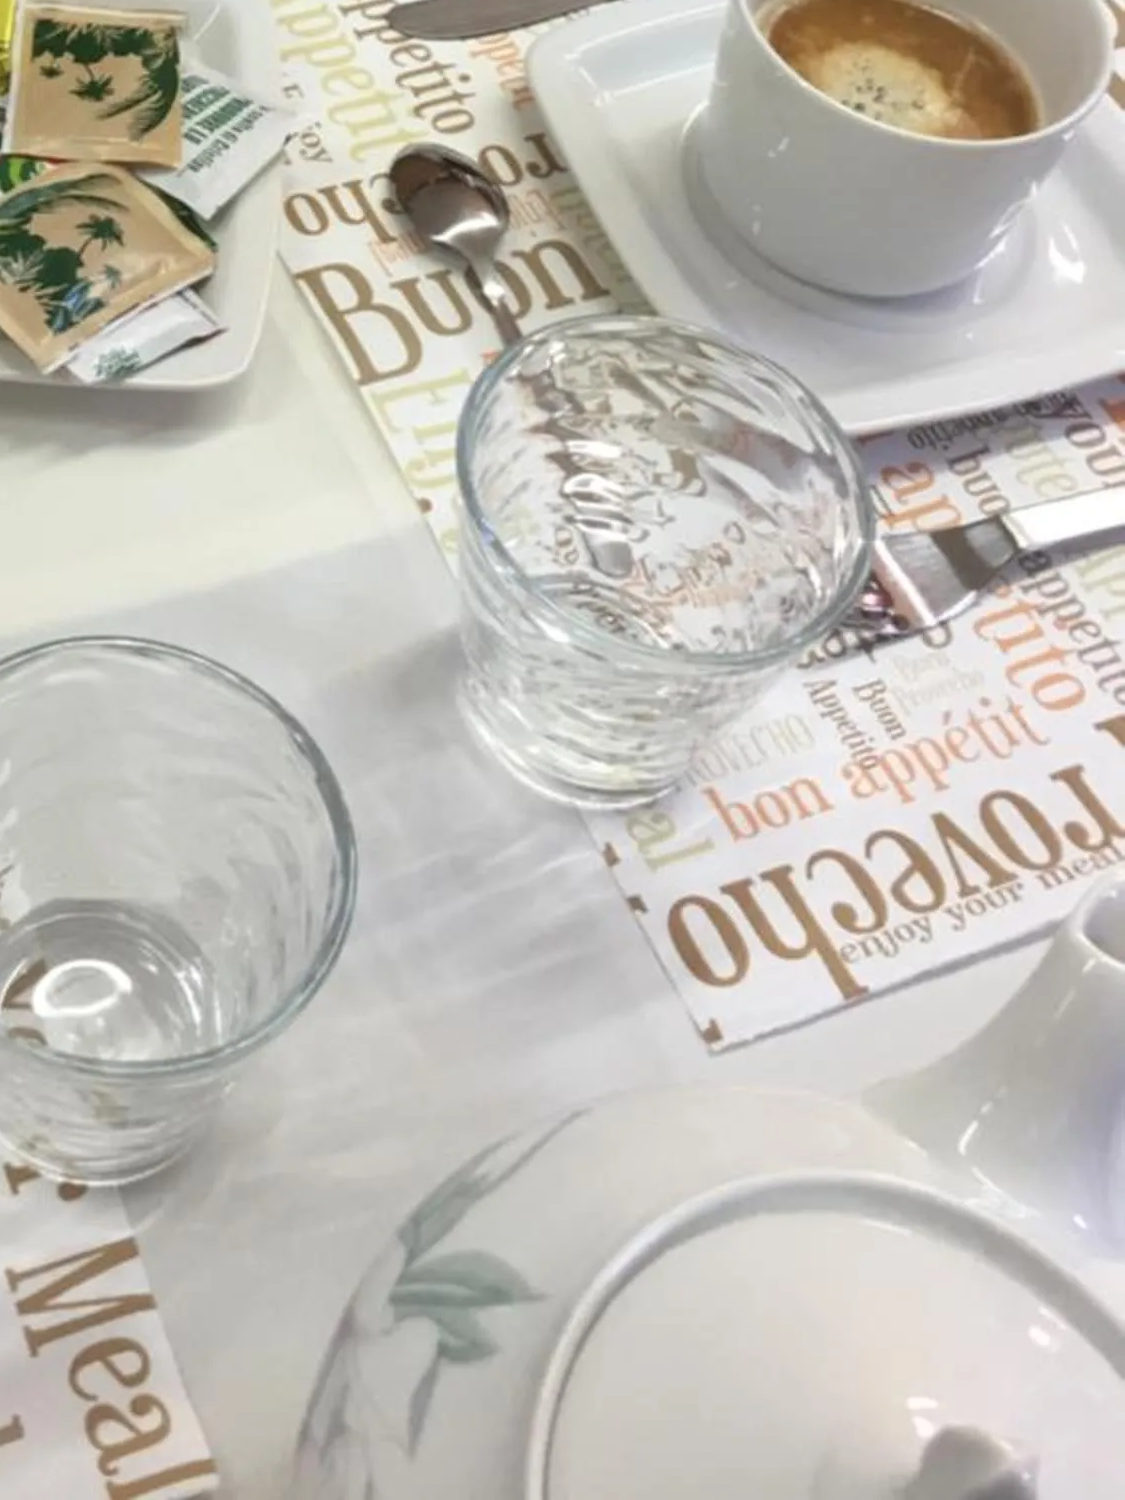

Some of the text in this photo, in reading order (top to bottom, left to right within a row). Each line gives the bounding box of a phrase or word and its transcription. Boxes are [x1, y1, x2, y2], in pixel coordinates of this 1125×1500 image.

[703, 774, 836, 844] bon
[841, 694, 1051, 806] appétit
[803, 677, 907, 771] Buon Appetito
[666, 714, 1125, 1002] rovecho
[840, 914, 934, 965] enjoy
[944, 881, 1024, 932] your
[4, 1236, 219, 1500] Meal
